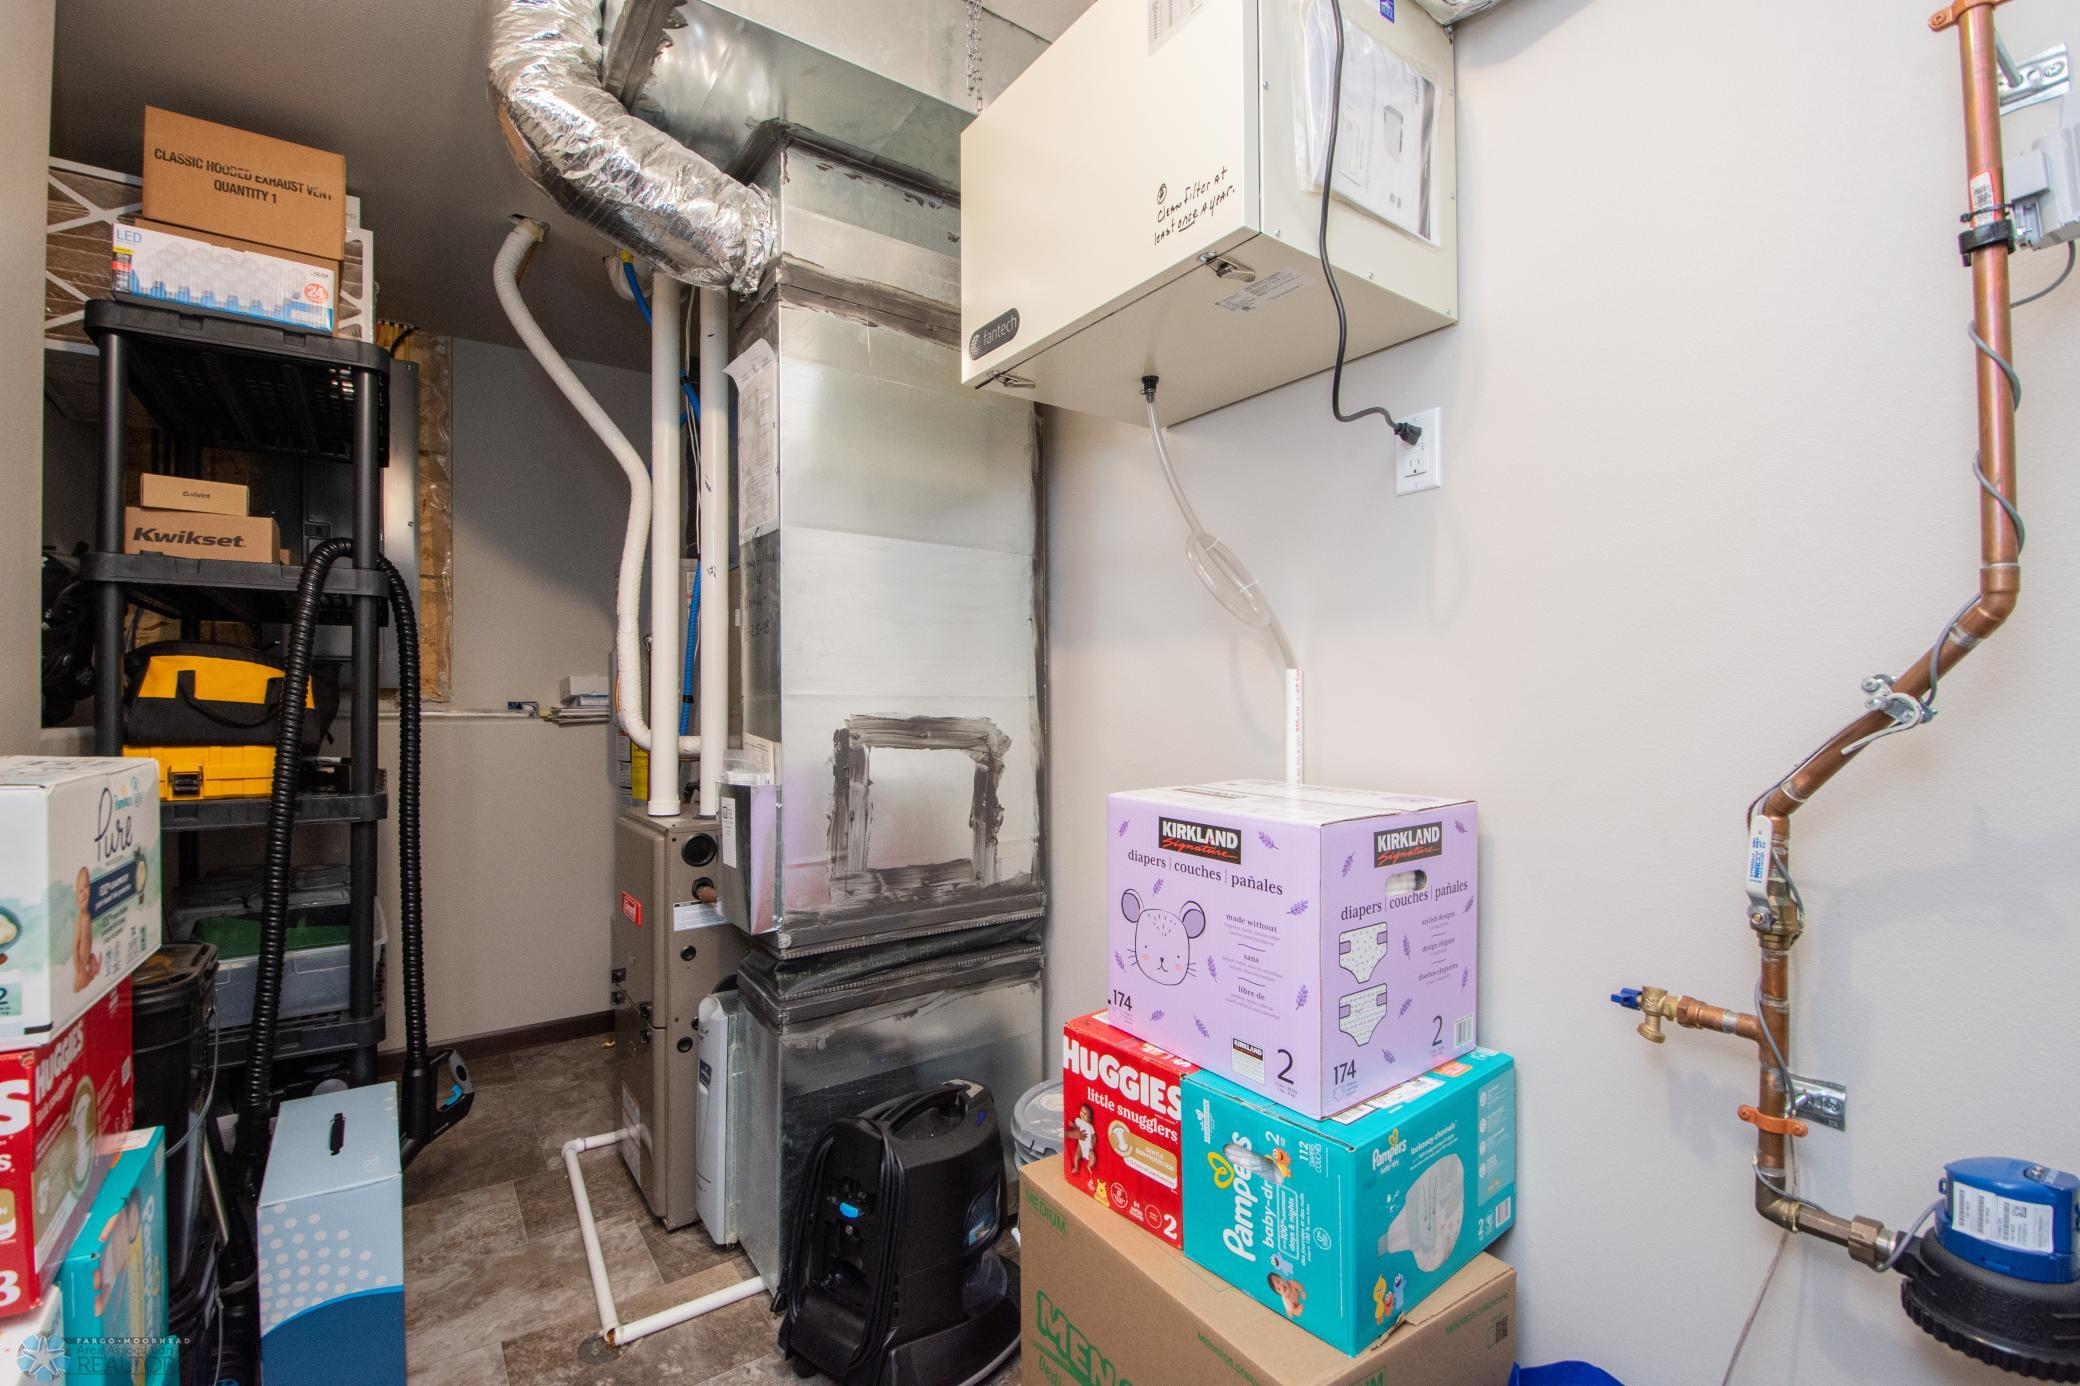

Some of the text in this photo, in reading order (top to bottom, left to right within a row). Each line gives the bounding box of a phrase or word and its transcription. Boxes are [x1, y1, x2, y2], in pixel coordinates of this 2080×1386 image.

[154, 148, 204, 170] CLASSIC
[206, 160, 252, 181] HOODED
[255, 174, 304, 194] EXHAUST
[214, 179, 277, 204] QUANTITY 1
[116, 228, 142, 243] LED
[307, 286, 323, 297] 24
[983, 315, 1017, 346] fantech
[132, 526, 245, 548] Kwikset
[94, 786, 133, 862] Pure
[1162, 820, 1239, 849] KIRKLAND
[1161, 837, 1239, 859] Signature
[1377, 826, 1440, 852] KIRKLAND
[1377, 846, 1440, 866] Signature
[1128, 849, 1283, 896] diapers couches pañales
[1341, 879, 1468, 921] diapers couches pañales
[1226, 914, 1278, 933] made without
[1243, 953, 1260, 964] sans
[1113, 989, 1133, 1012] 174
[1238, 985, 1265, 1001] libre de
[1432, 1015, 1443, 1047] 2
[1234, 1039, 1263, 1056] KIRKLAND
[35, 1019, 85, 1106] HUGGIES
[1277, 1048, 1294, 1085] 2
[1333, 1059, 1357, 1086] 174
[1063, 1035, 1181, 1121] HUGGIES
[1087, 1086, 1178, 1142] little snugglers
[1265, 1130, 1280, 1146] 2
[1299, 1141, 1309, 1161] 112
[1372, 1139, 1407, 1172] Pampers
[1223, 1132, 1256, 1262] Pampes
[1025, 1187, 1067, 1235] MEDIUM
[1262, 1180, 1276, 1248] baby-dr
[1163, 1214, 1178, 1240] 2
[1478, 1218, 1484, 1236] 2
